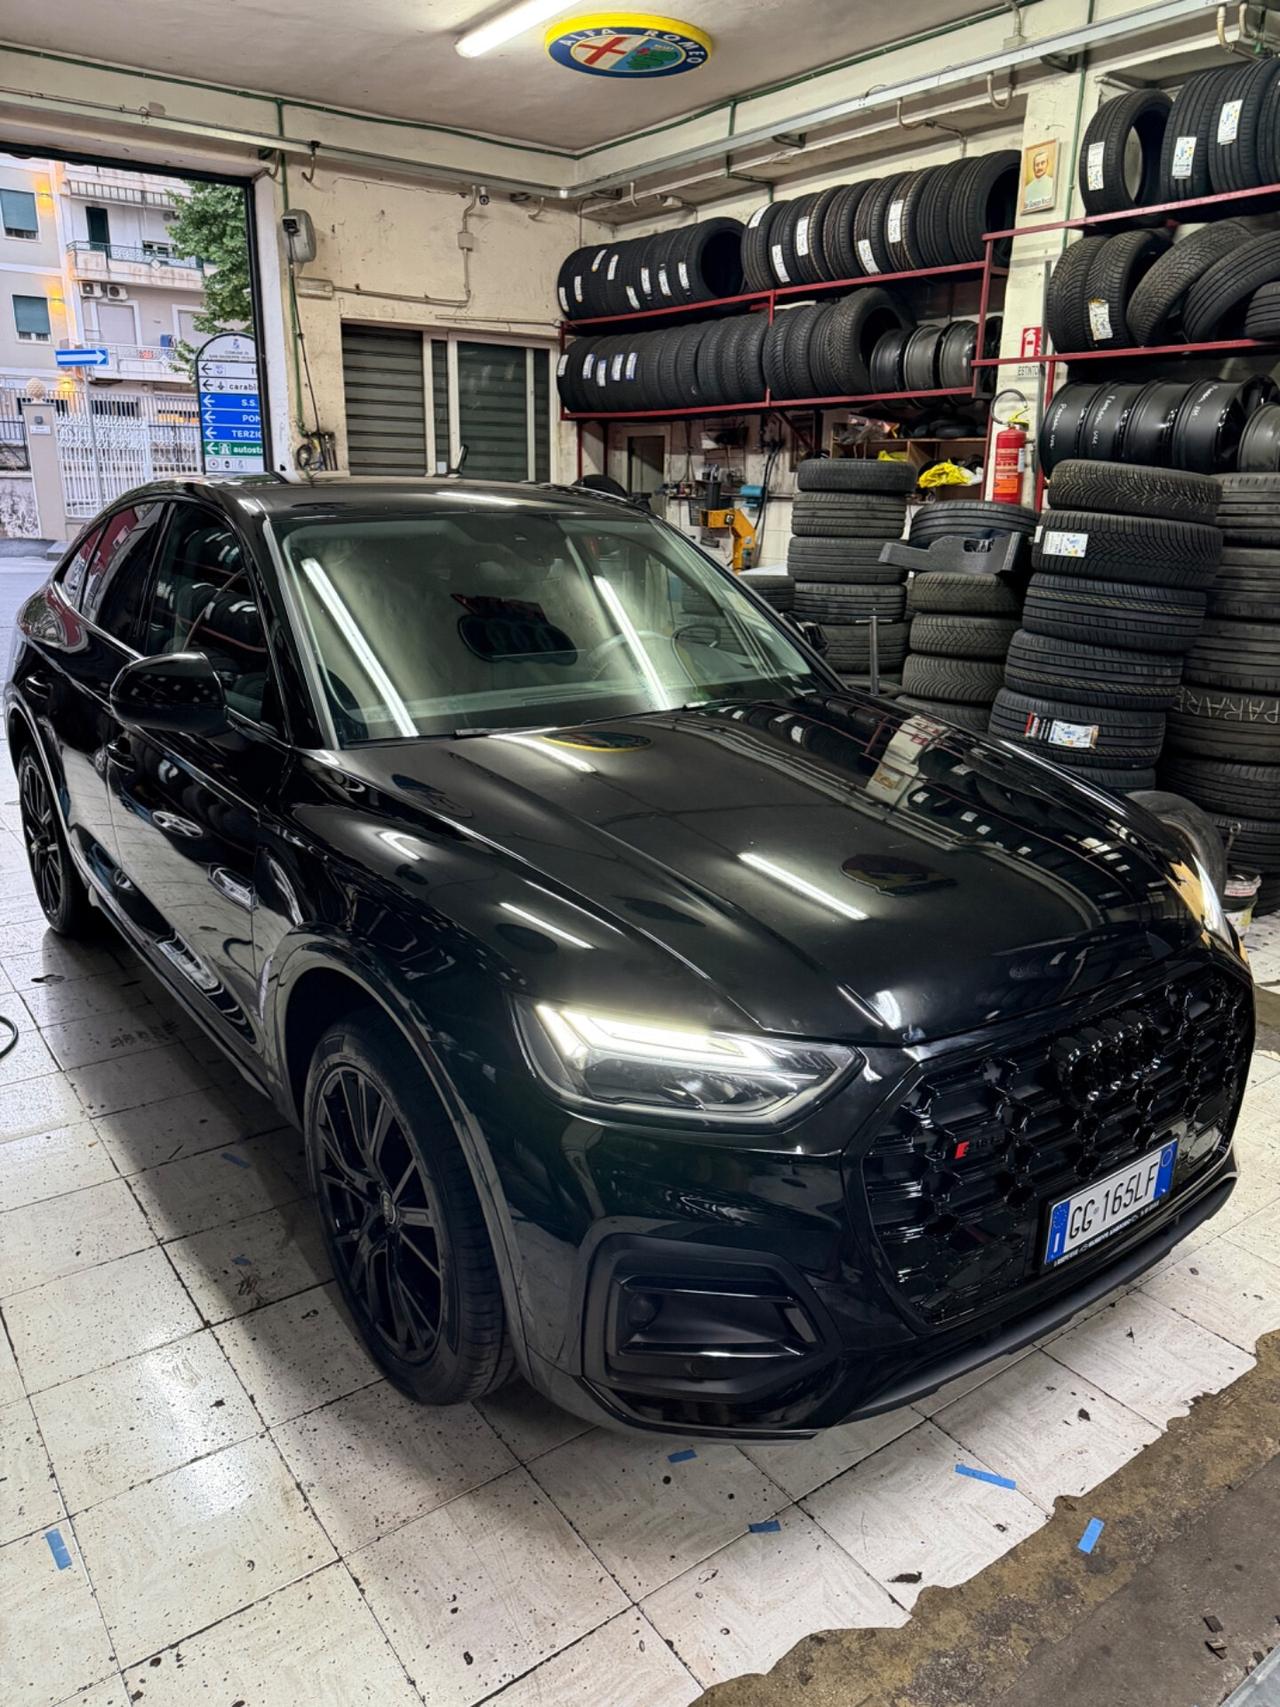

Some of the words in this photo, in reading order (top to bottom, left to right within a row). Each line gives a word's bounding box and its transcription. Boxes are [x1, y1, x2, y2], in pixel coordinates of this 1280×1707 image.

[558, 28, 617, 47] ALFA
[644, 29, 705, 64] ROMEO
[1069, 1198, 1095, 1240] GG
